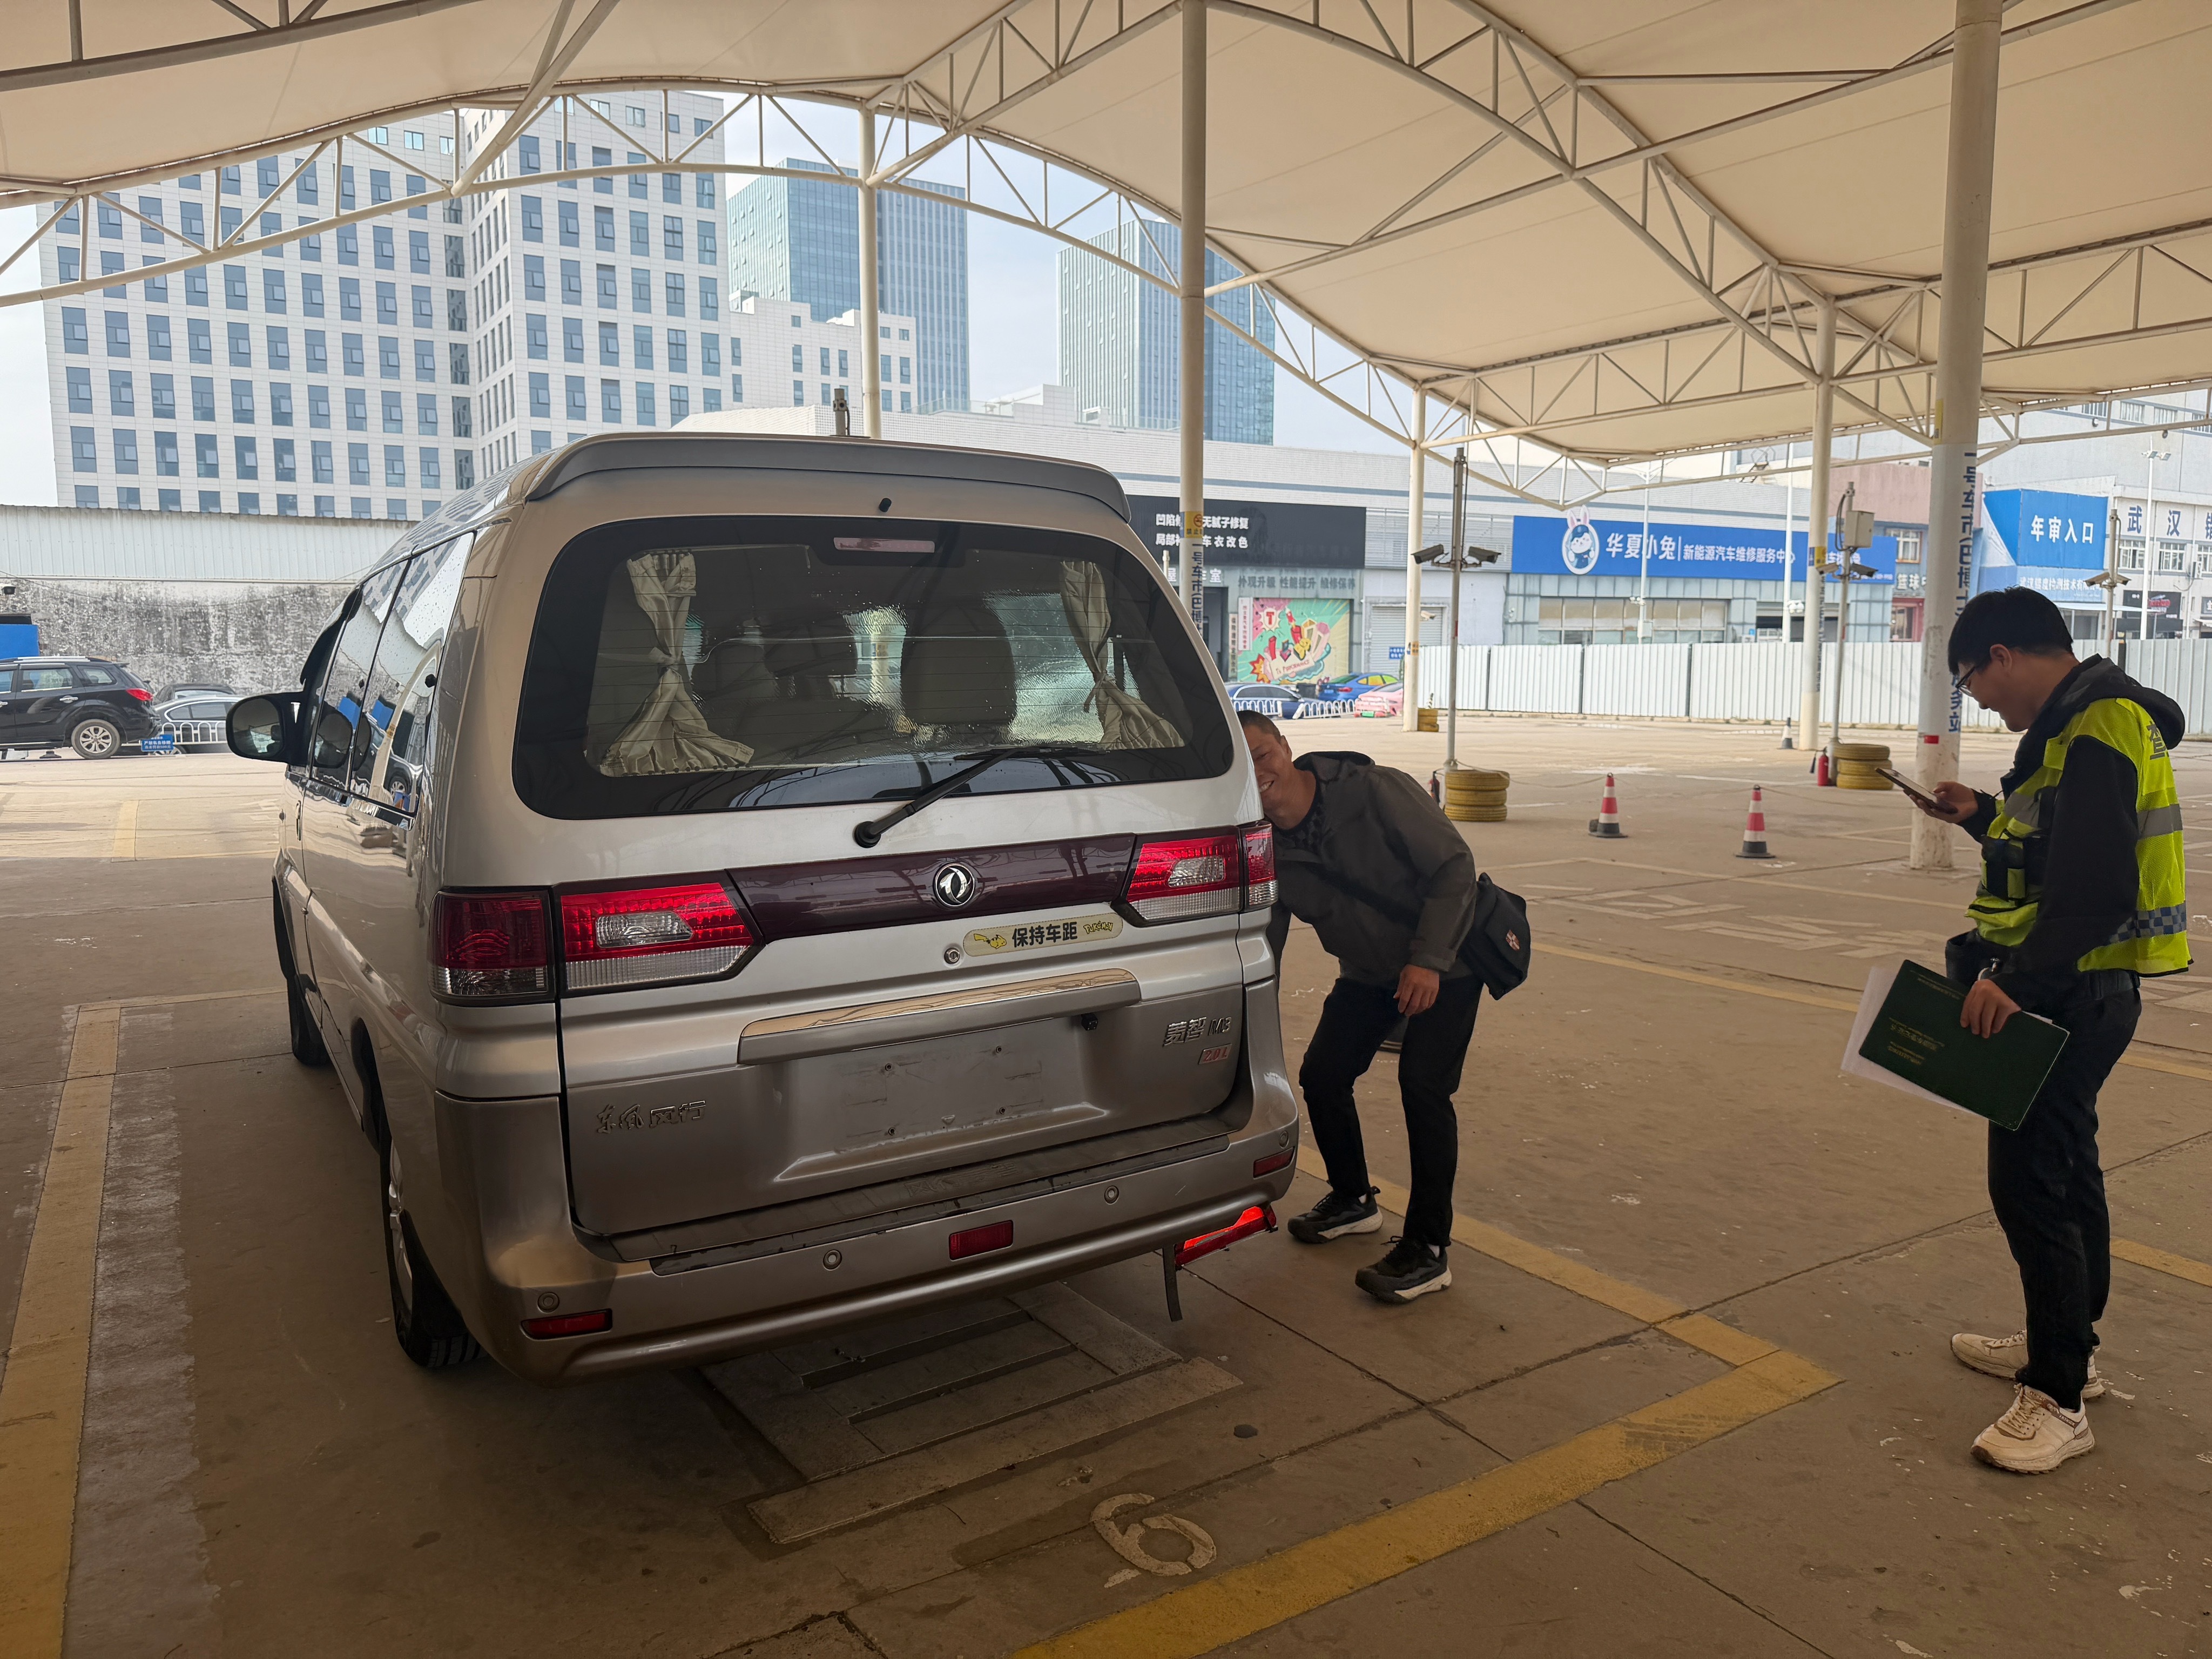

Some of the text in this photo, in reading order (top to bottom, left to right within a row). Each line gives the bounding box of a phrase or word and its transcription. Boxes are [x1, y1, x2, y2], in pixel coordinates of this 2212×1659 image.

[1202, 516, 1249, 530] 无腻子修复
[2031, 515, 2094, 544] 年审入口
[1202, 535, 1249, 549] 车衣改色
[1606, 532, 1676, 561] 华夏小兔
[1012, 921, 1077, 948] 保持车距
[1163, 1017, 1232, 1047] 菱智 M3
